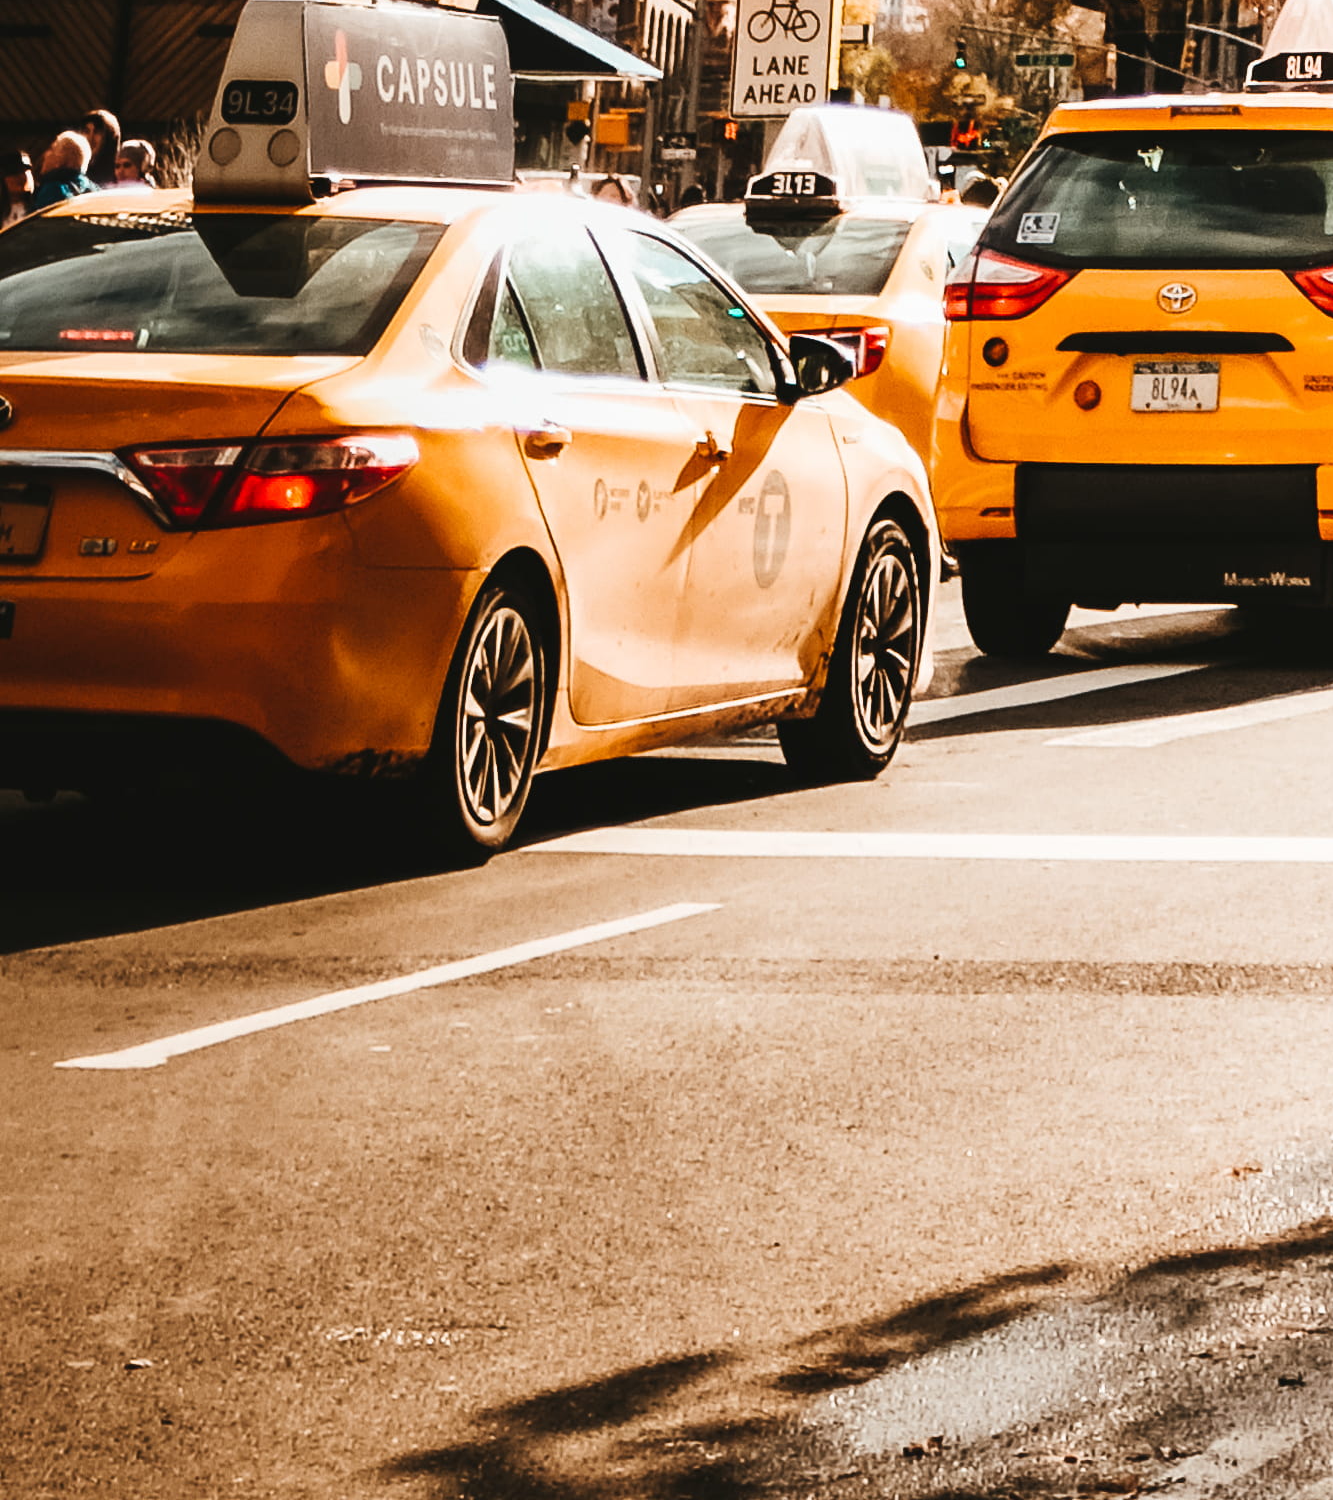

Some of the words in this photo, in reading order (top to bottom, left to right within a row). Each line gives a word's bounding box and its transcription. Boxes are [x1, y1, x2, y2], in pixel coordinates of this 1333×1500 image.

[752, 55, 809, 77] LANE
[1286, 55, 1323, 79] 8L94
[376, 54, 498, 110] CAPSULE
[227, 89, 294, 116] 9L34
[743, 84, 816, 104] AHEAD
[771, 173, 816, 194] 3L13
